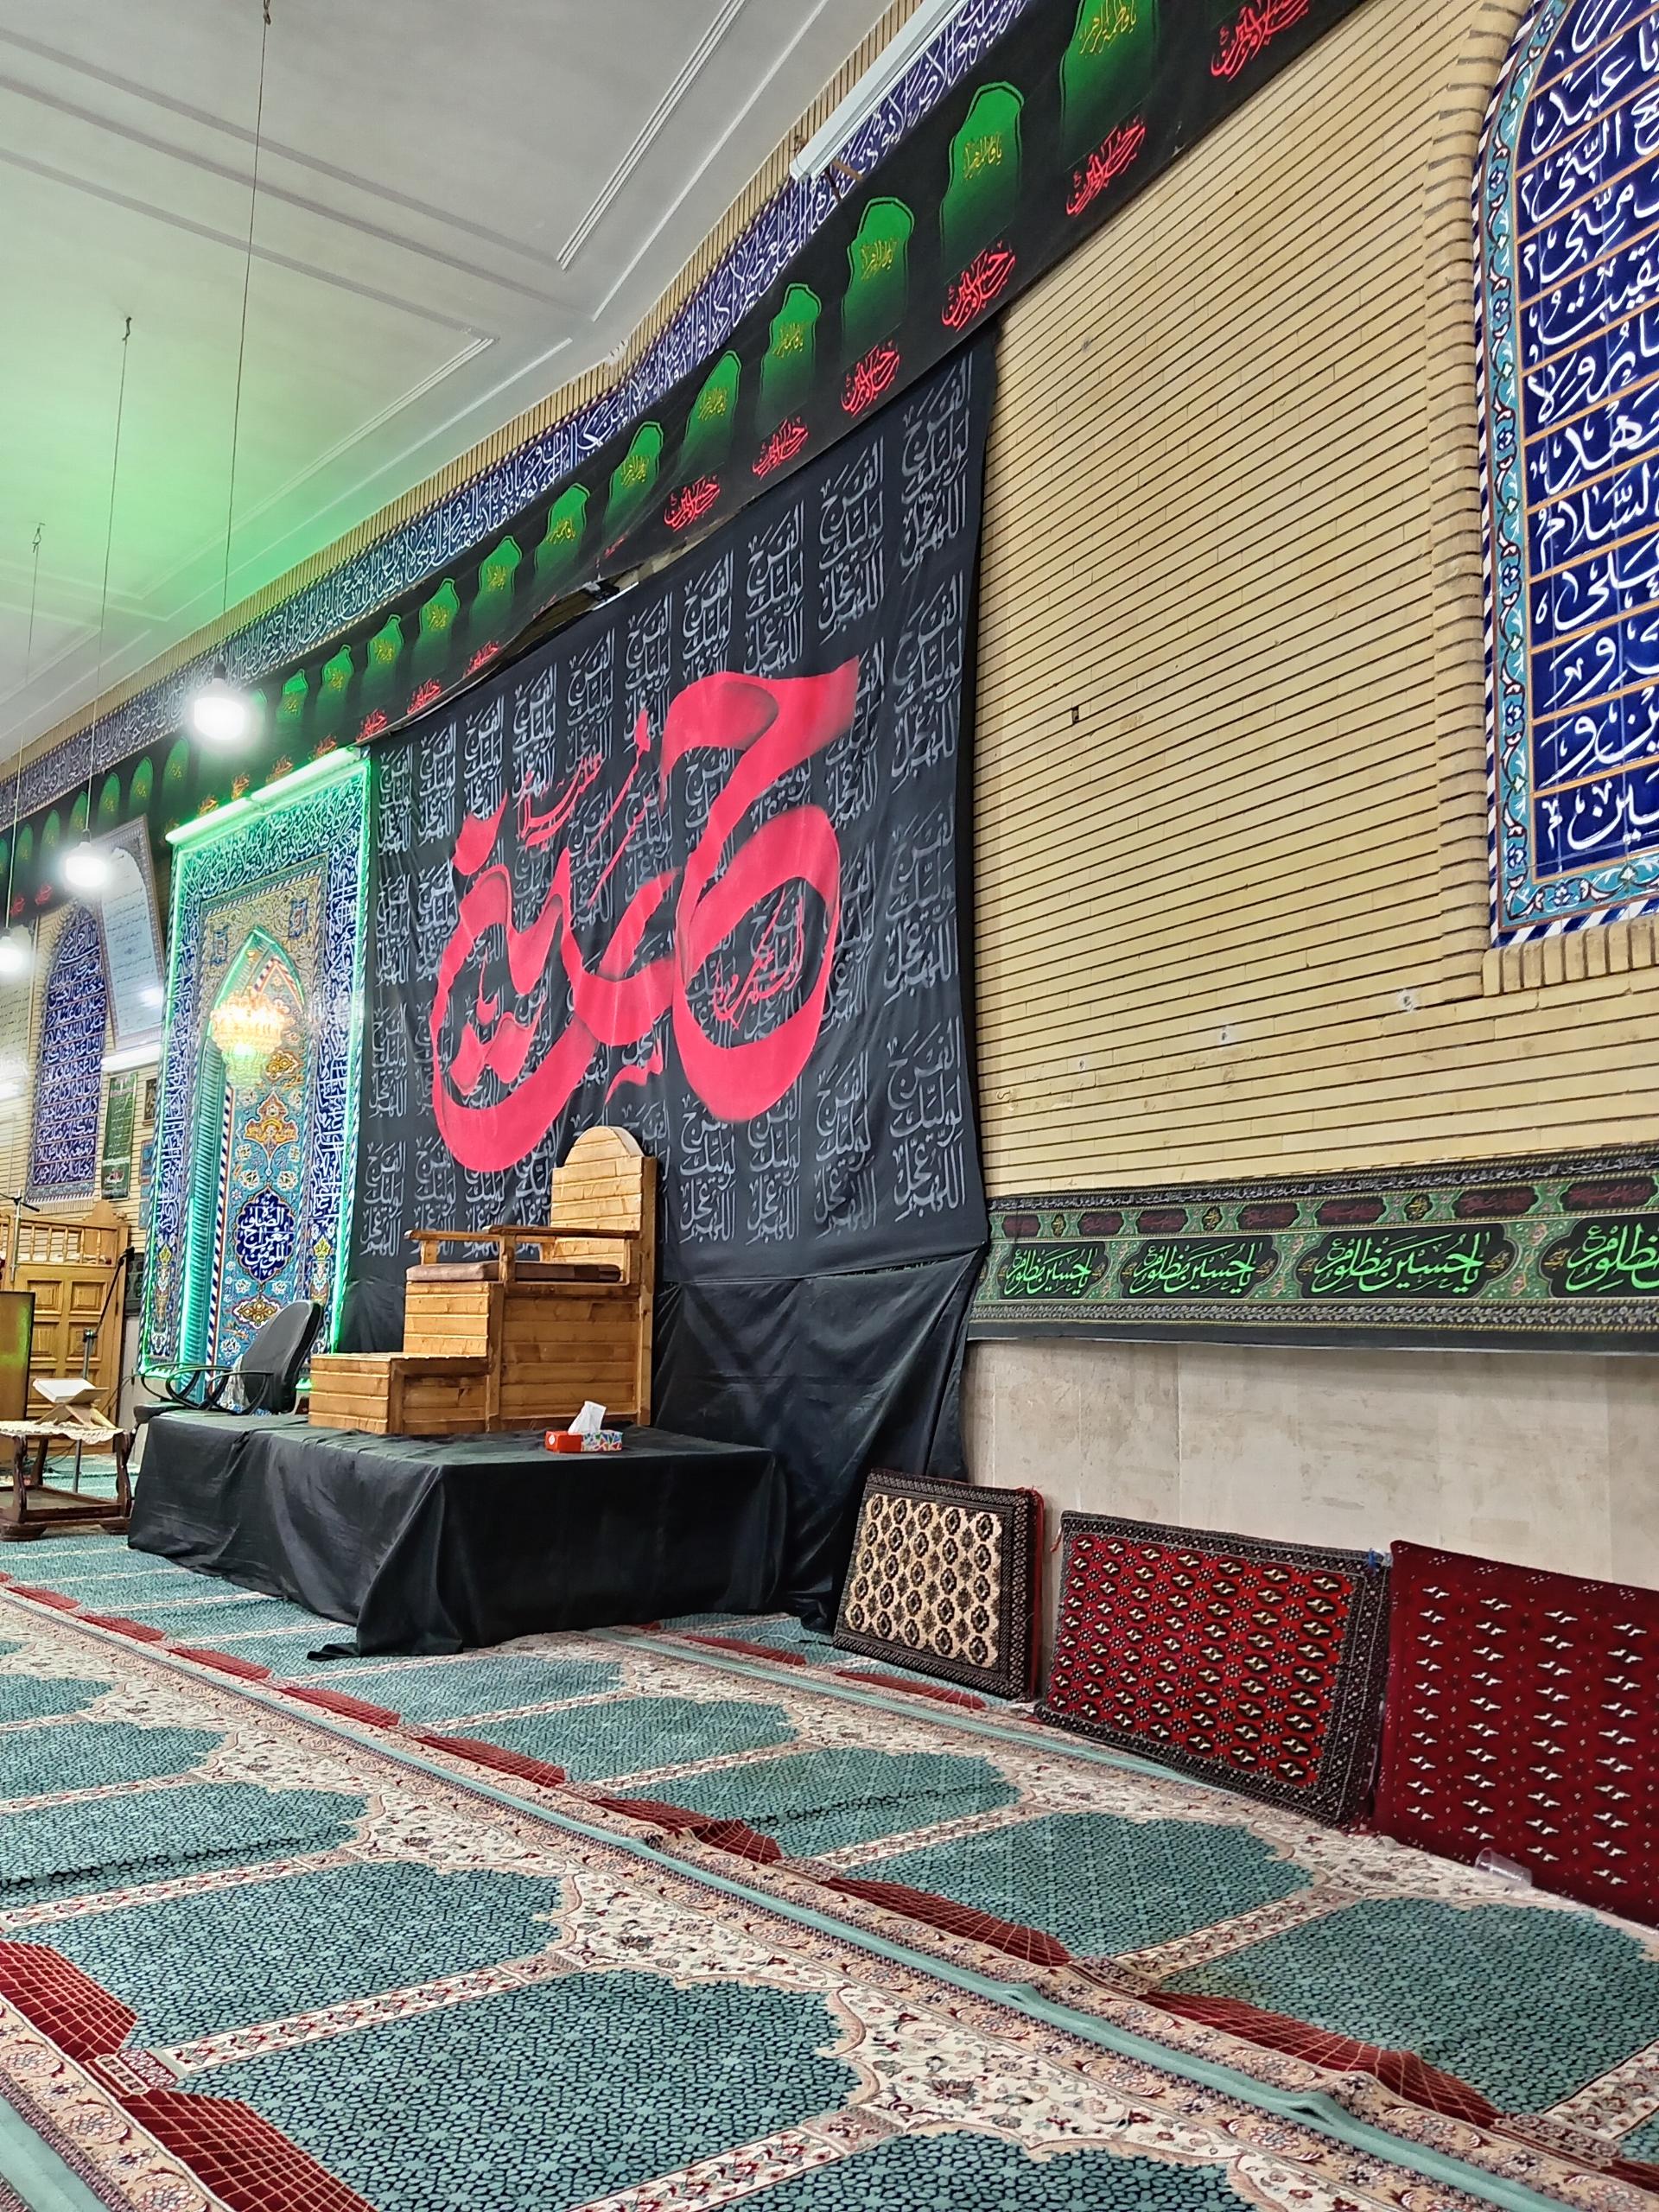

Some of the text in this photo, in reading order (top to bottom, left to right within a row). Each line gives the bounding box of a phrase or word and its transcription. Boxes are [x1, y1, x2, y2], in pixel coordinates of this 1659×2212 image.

[244, 1227, 289, 1249] معراج
[1004, 1249, 1046, 1294] مظلوم
[1128, 1245, 1192, 1294] مظلوم
[1310, 1236, 1393, 1294] مظلوم
